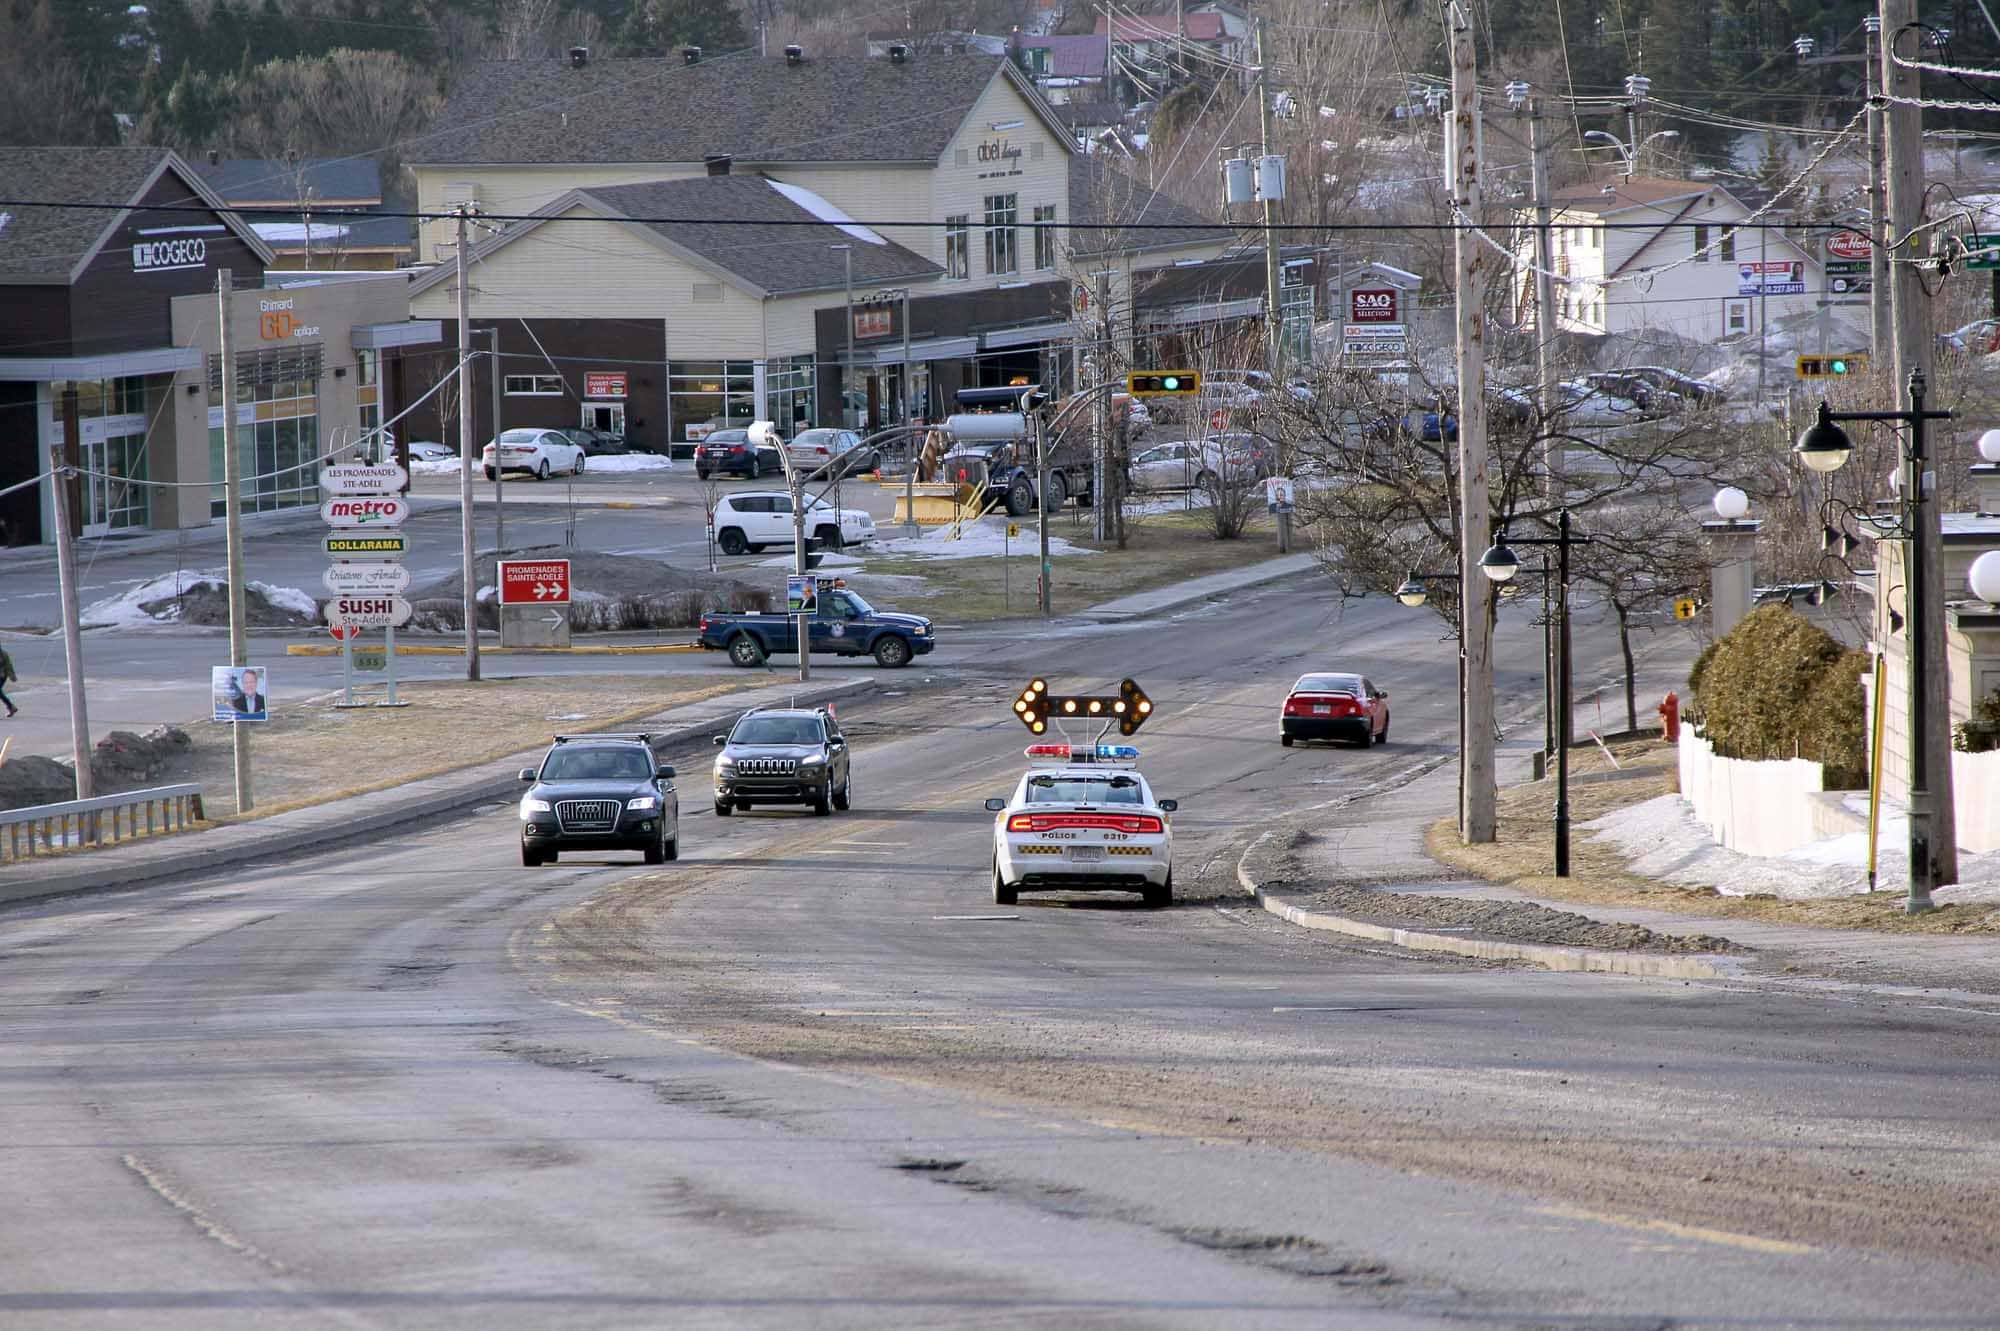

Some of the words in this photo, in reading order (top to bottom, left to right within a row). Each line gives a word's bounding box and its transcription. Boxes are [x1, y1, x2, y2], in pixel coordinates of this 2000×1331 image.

[1830, 238, 1848, 249] Tim
[151, 238, 206, 265] COGECO
[329, 470, 341, 478] LES
[343, 468, 396, 478] PROMENADES
[331, 501, 397, 516] metro
[329, 541, 401, 550] DOLLARAMA
[506, 566, 564, 574] PROMENADES
[339, 600, 392, 614] SUSHI
